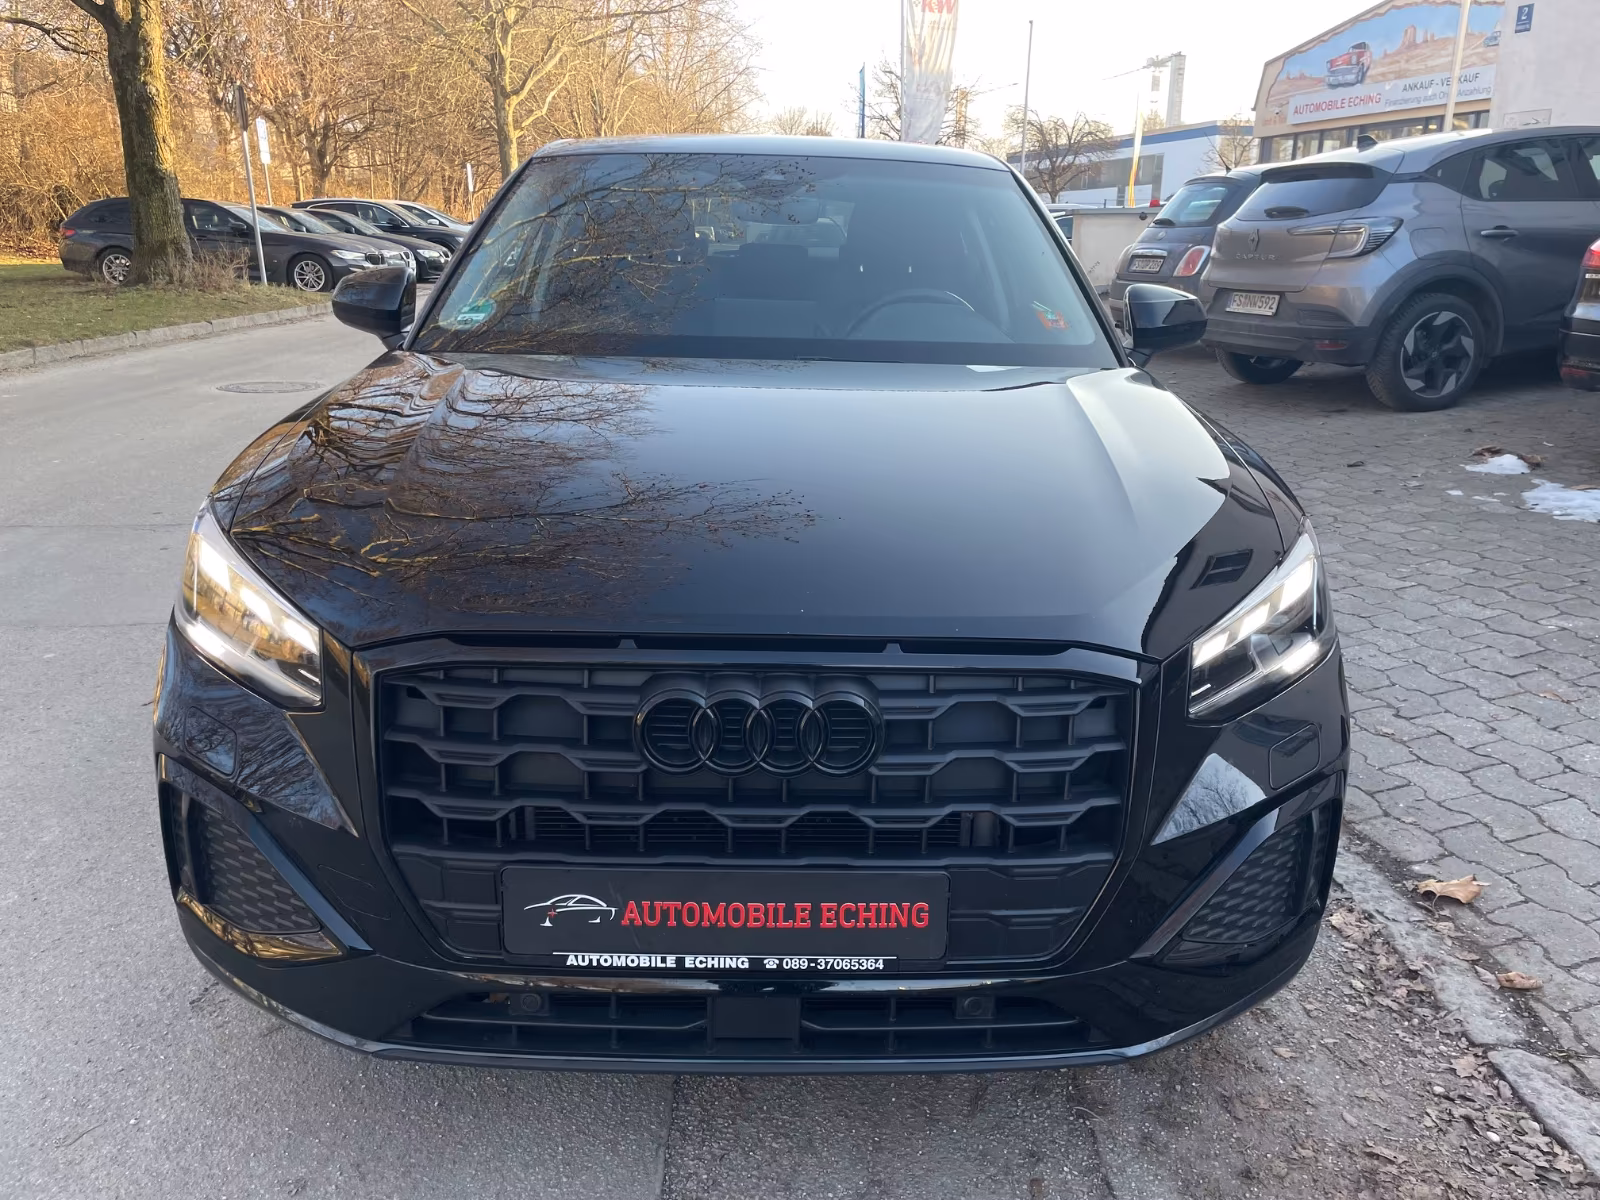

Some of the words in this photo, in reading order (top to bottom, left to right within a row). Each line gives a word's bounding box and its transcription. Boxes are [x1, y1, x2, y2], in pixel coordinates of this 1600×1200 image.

[1521, 7, 1529, 20] 2
[1402, 79, 1435, 92] ANKAUF
[1441, 72, 1480, 87] VEKAUF
[1293, 97, 1346, 116] AUTOMOBILE
[1347, 92, 1382, 108] ECHING
[1235, 253, 1276, 261] CAPTUR
[621, 900, 813, 929] AUTOMOBILE
[819, 902, 930, 930] ECHING
[565, 953, 677, 969] AUTOMOBILE
[684, 955, 750, 970] ECHING
[782, 957, 885, 971] 089-37065364
